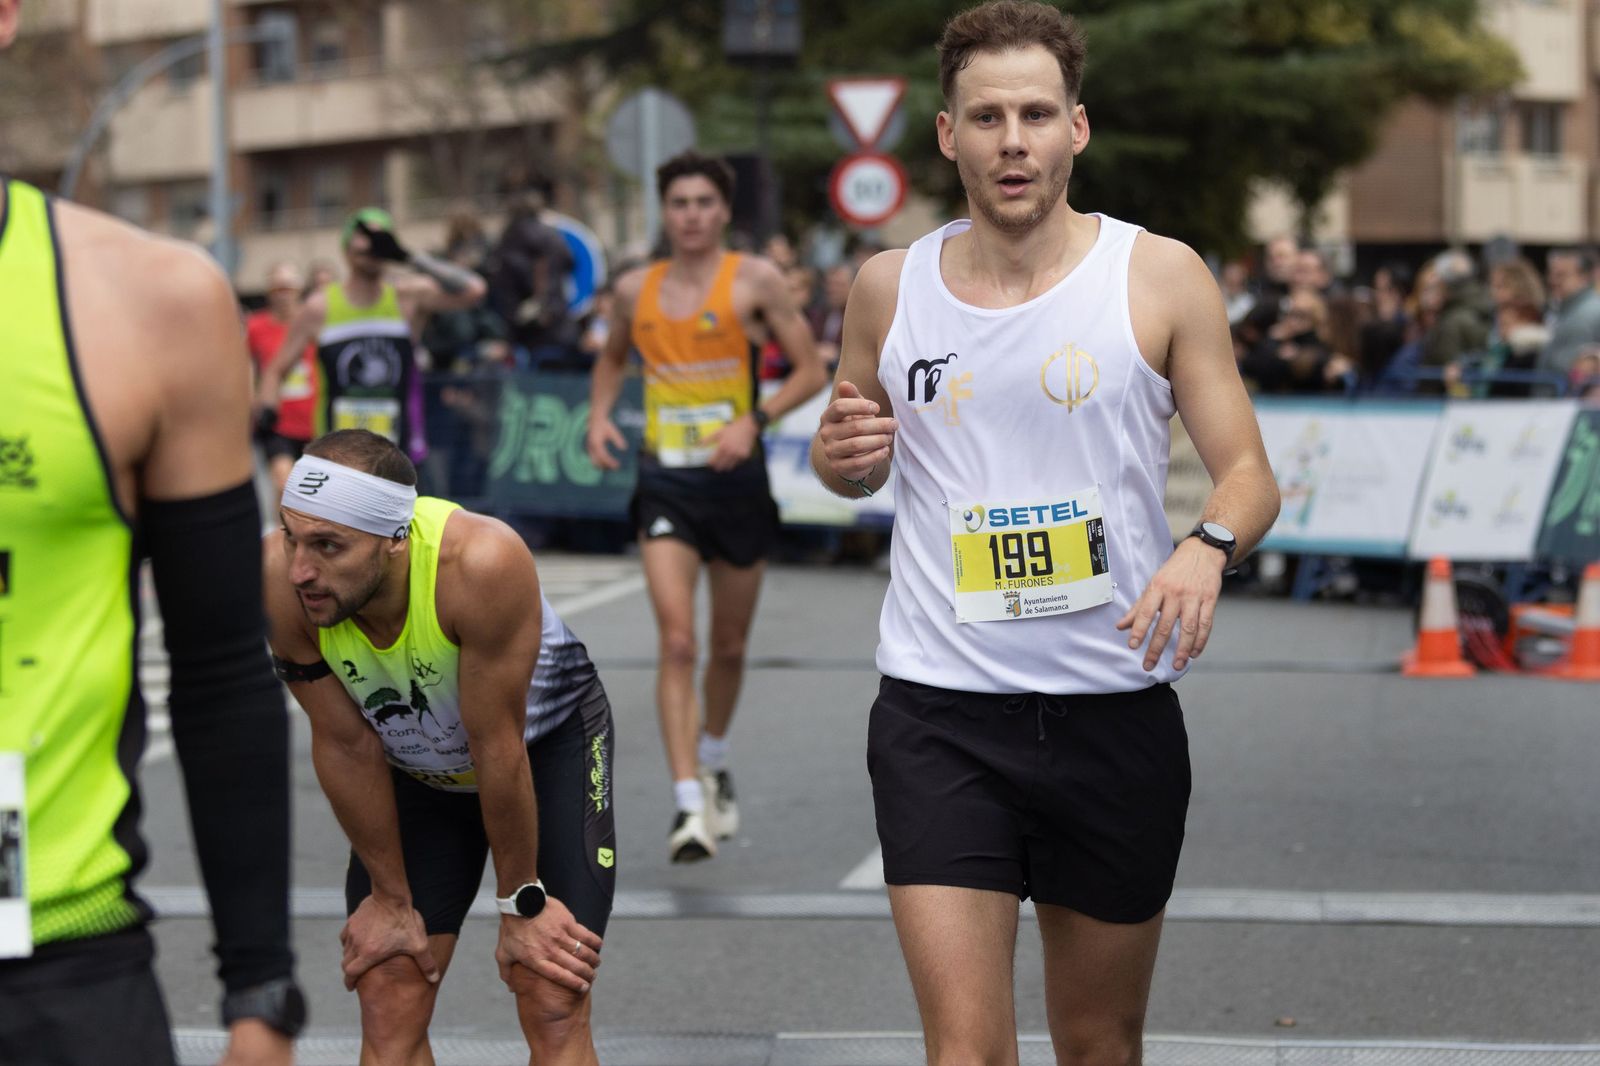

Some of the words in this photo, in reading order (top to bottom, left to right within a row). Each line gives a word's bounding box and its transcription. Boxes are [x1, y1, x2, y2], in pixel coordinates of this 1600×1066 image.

[988, 500, 1088, 527] SETEL
[988, 530, 1054, 580] 199
[1023, 594, 1068, 606] Ayuntamiento
[1024, 606, 1033, 615] de
[1034, 603, 1069, 614] Salamanca
